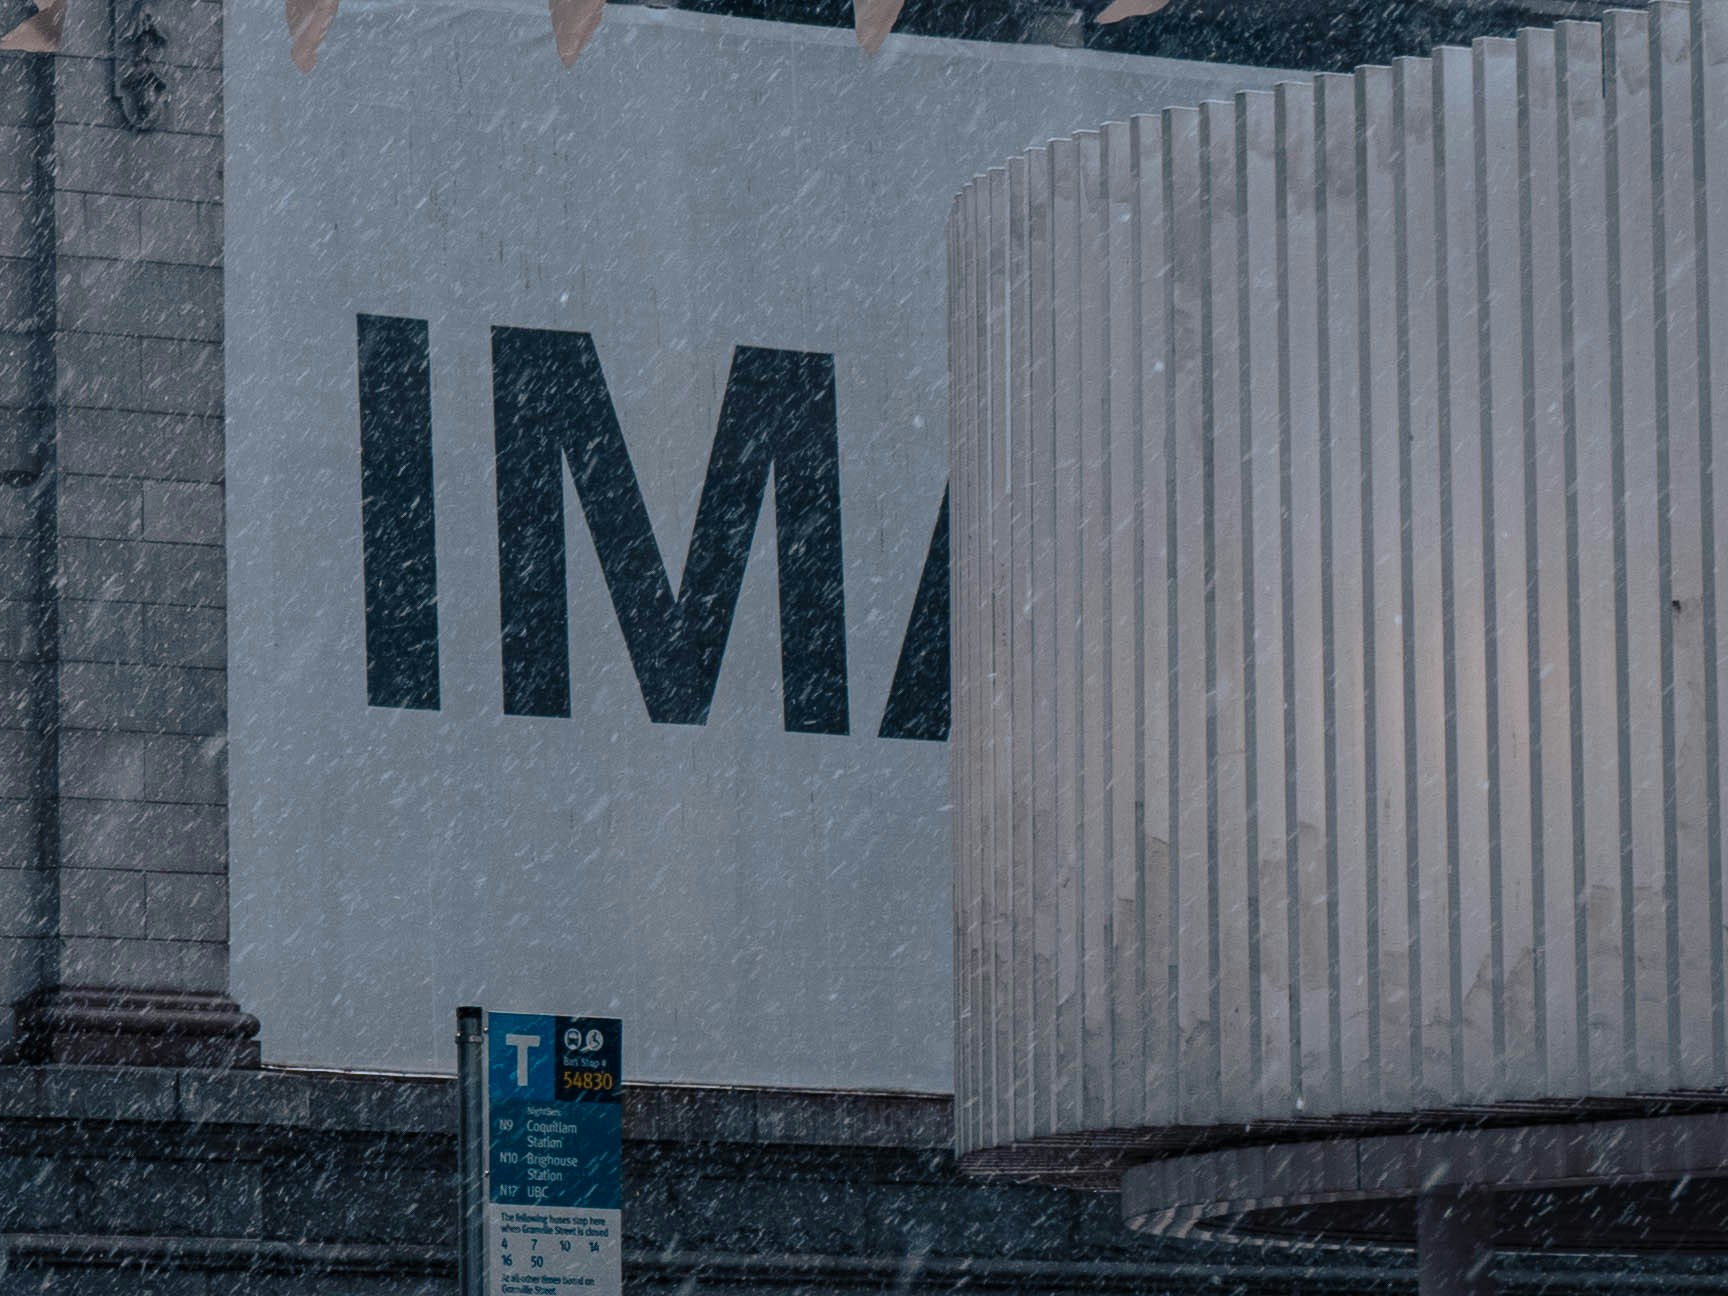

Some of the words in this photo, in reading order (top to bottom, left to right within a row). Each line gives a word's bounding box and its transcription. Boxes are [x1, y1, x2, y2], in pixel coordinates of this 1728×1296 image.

[505, 1033, 541, 1087] T
[563, 1056, 578, 1066] Bus
[581, 1057, 600, 1069] Stop
[563, 1071, 613, 1091] 54830
[499, 1119, 514, 1131] N9
[526, 1119, 578, 1135] Coquitlam
[527, 1135, 563, 1149] Station
[499, 1151, 519, 1164] N10
[527, 1152, 579, 1168] Brighouse
[527, 1168, 563, 1181] Station
[499, 1184, 519, 1196] N17
[527, 1185, 549, 1198] UBC
[501, 1212, 514, 1221] The
[549, 1214, 571, 1224] buses
[572, 1216, 588, 1226] stop
[590, 1216, 606, 1226] here
[530, 1238, 538, 1251] 7
[560, 1240, 571, 1252] 10
[589, 1241, 600, 1253] 14
[501, 1254, 513, 1266] 16
[530, 1255, 544, 1268] 50
